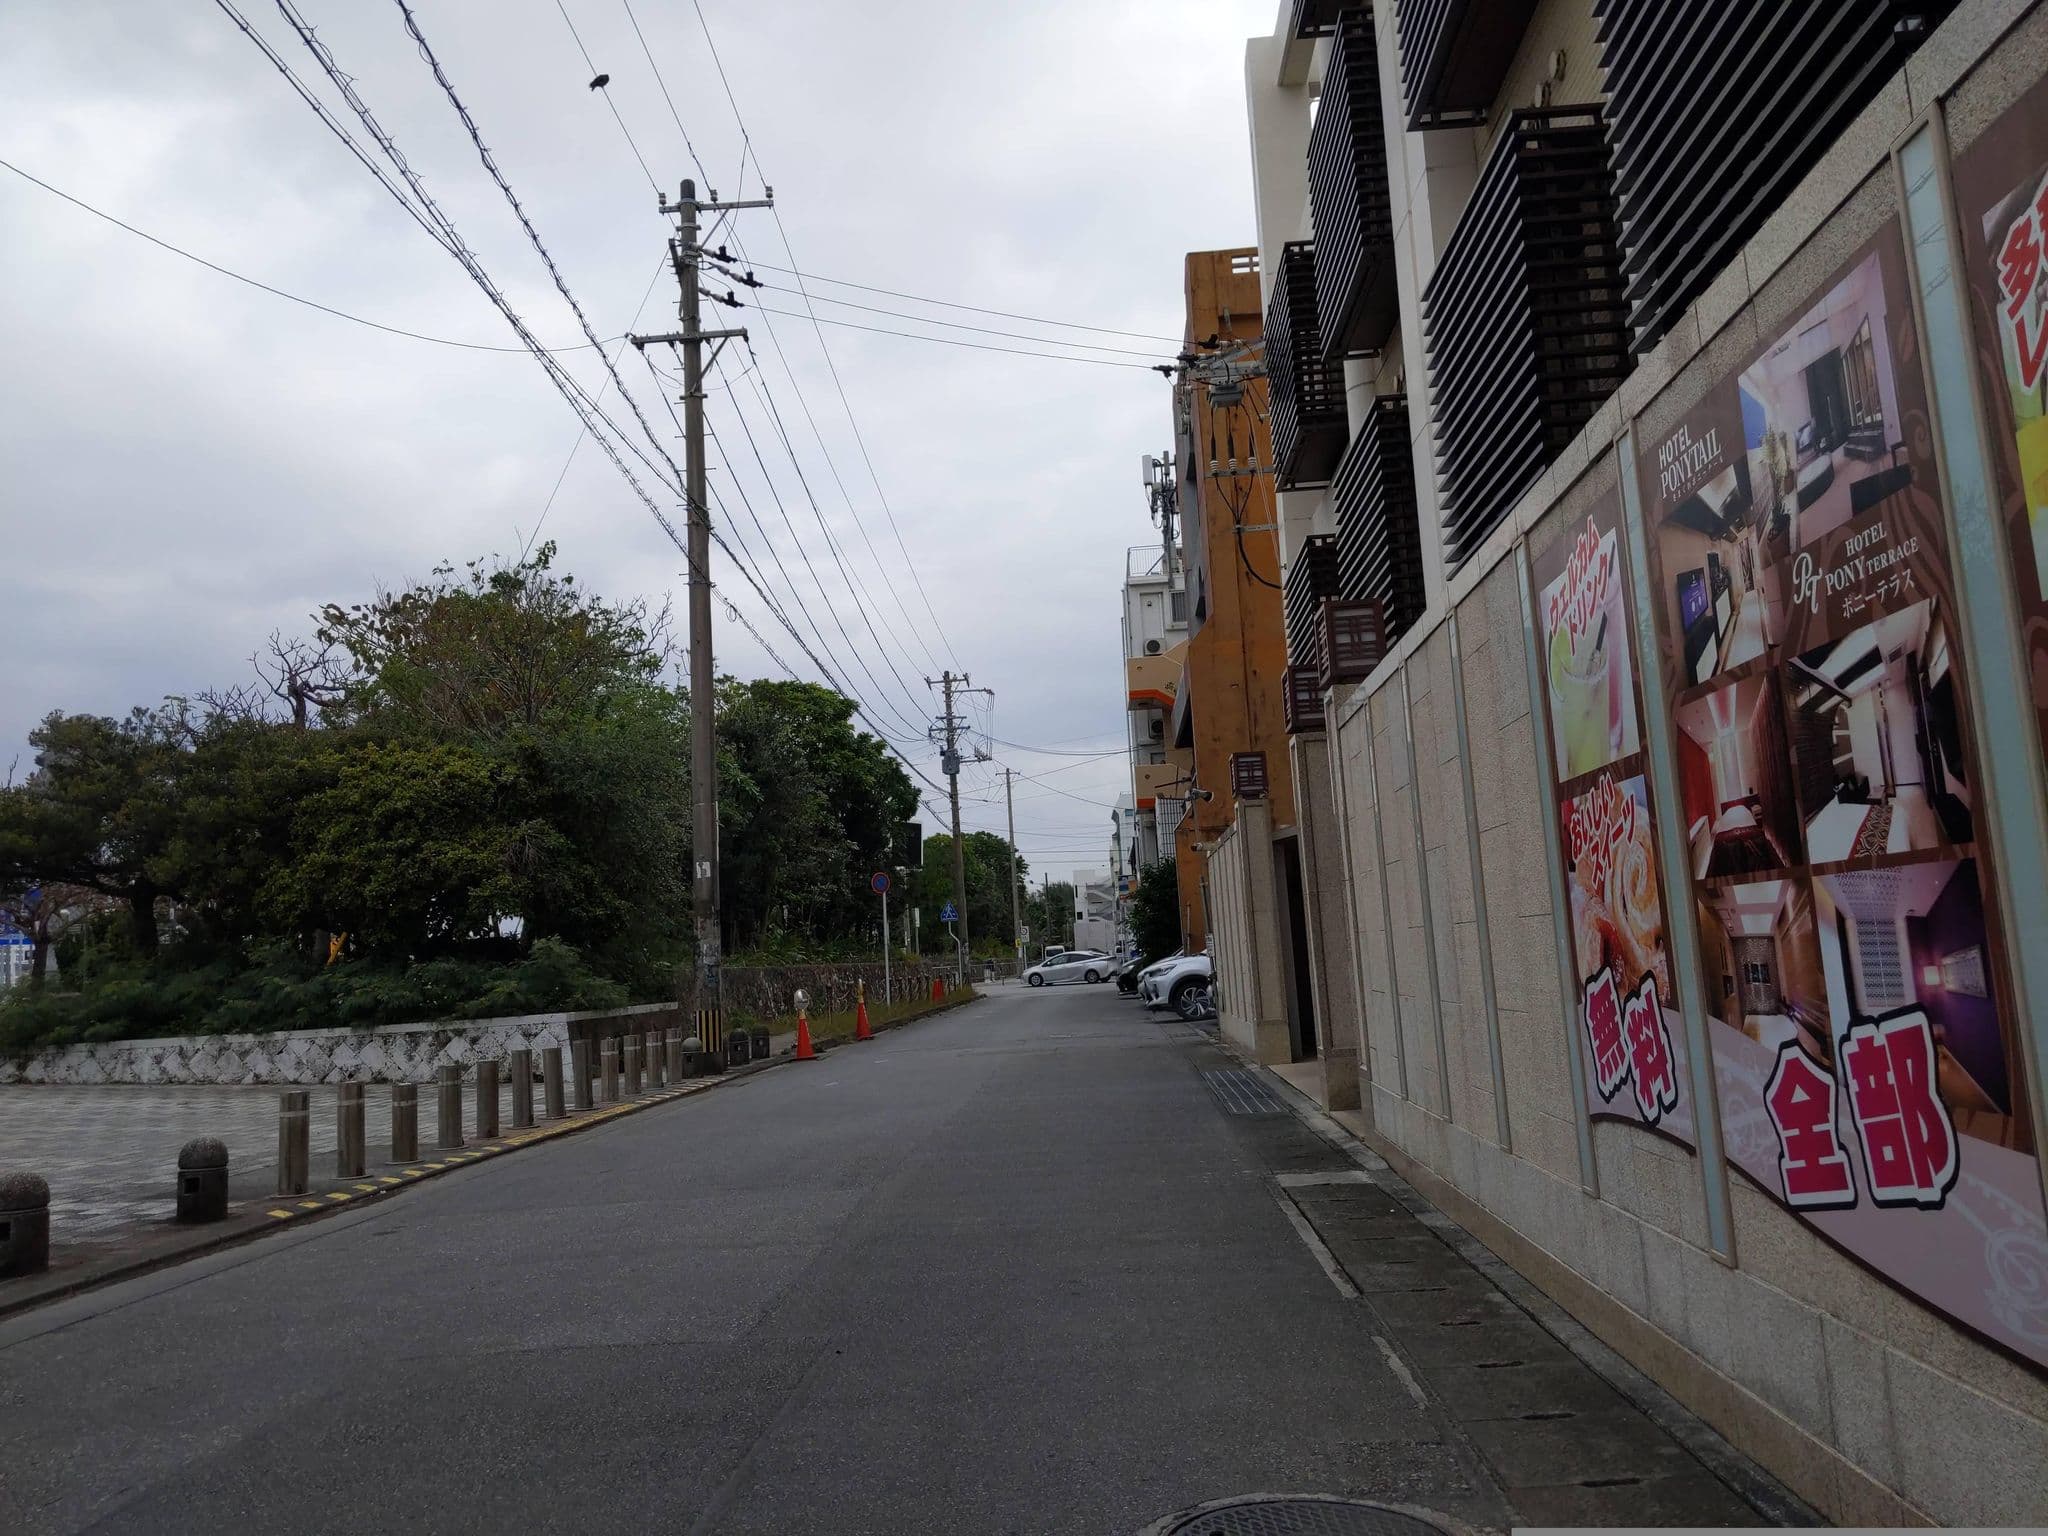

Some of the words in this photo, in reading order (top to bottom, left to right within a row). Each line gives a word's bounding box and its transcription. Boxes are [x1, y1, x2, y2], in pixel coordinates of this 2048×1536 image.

[1658, 424, 1692, 470] HOTEL
[1661, 427, 1721, 499] PONYTAIL
[1549, 517, 1600, 636] ウェルカム
[1825, 556, 1866, 596] PONY
[1866, 537, 1920, 576] TERRACE
[1845, 521, 1887, 557] HOTEL
[1568, 552, 1608, 657] ドリンク
[1842, 568, 1915, 618] ポニーテラス
[1570, 775, 1615, 862] おいしい
[1590, 793, 1636, 888] スイーツ
[1586, 967, 1676, 1119] 無料
[1767, 1012, 1955, 1203] 全部
